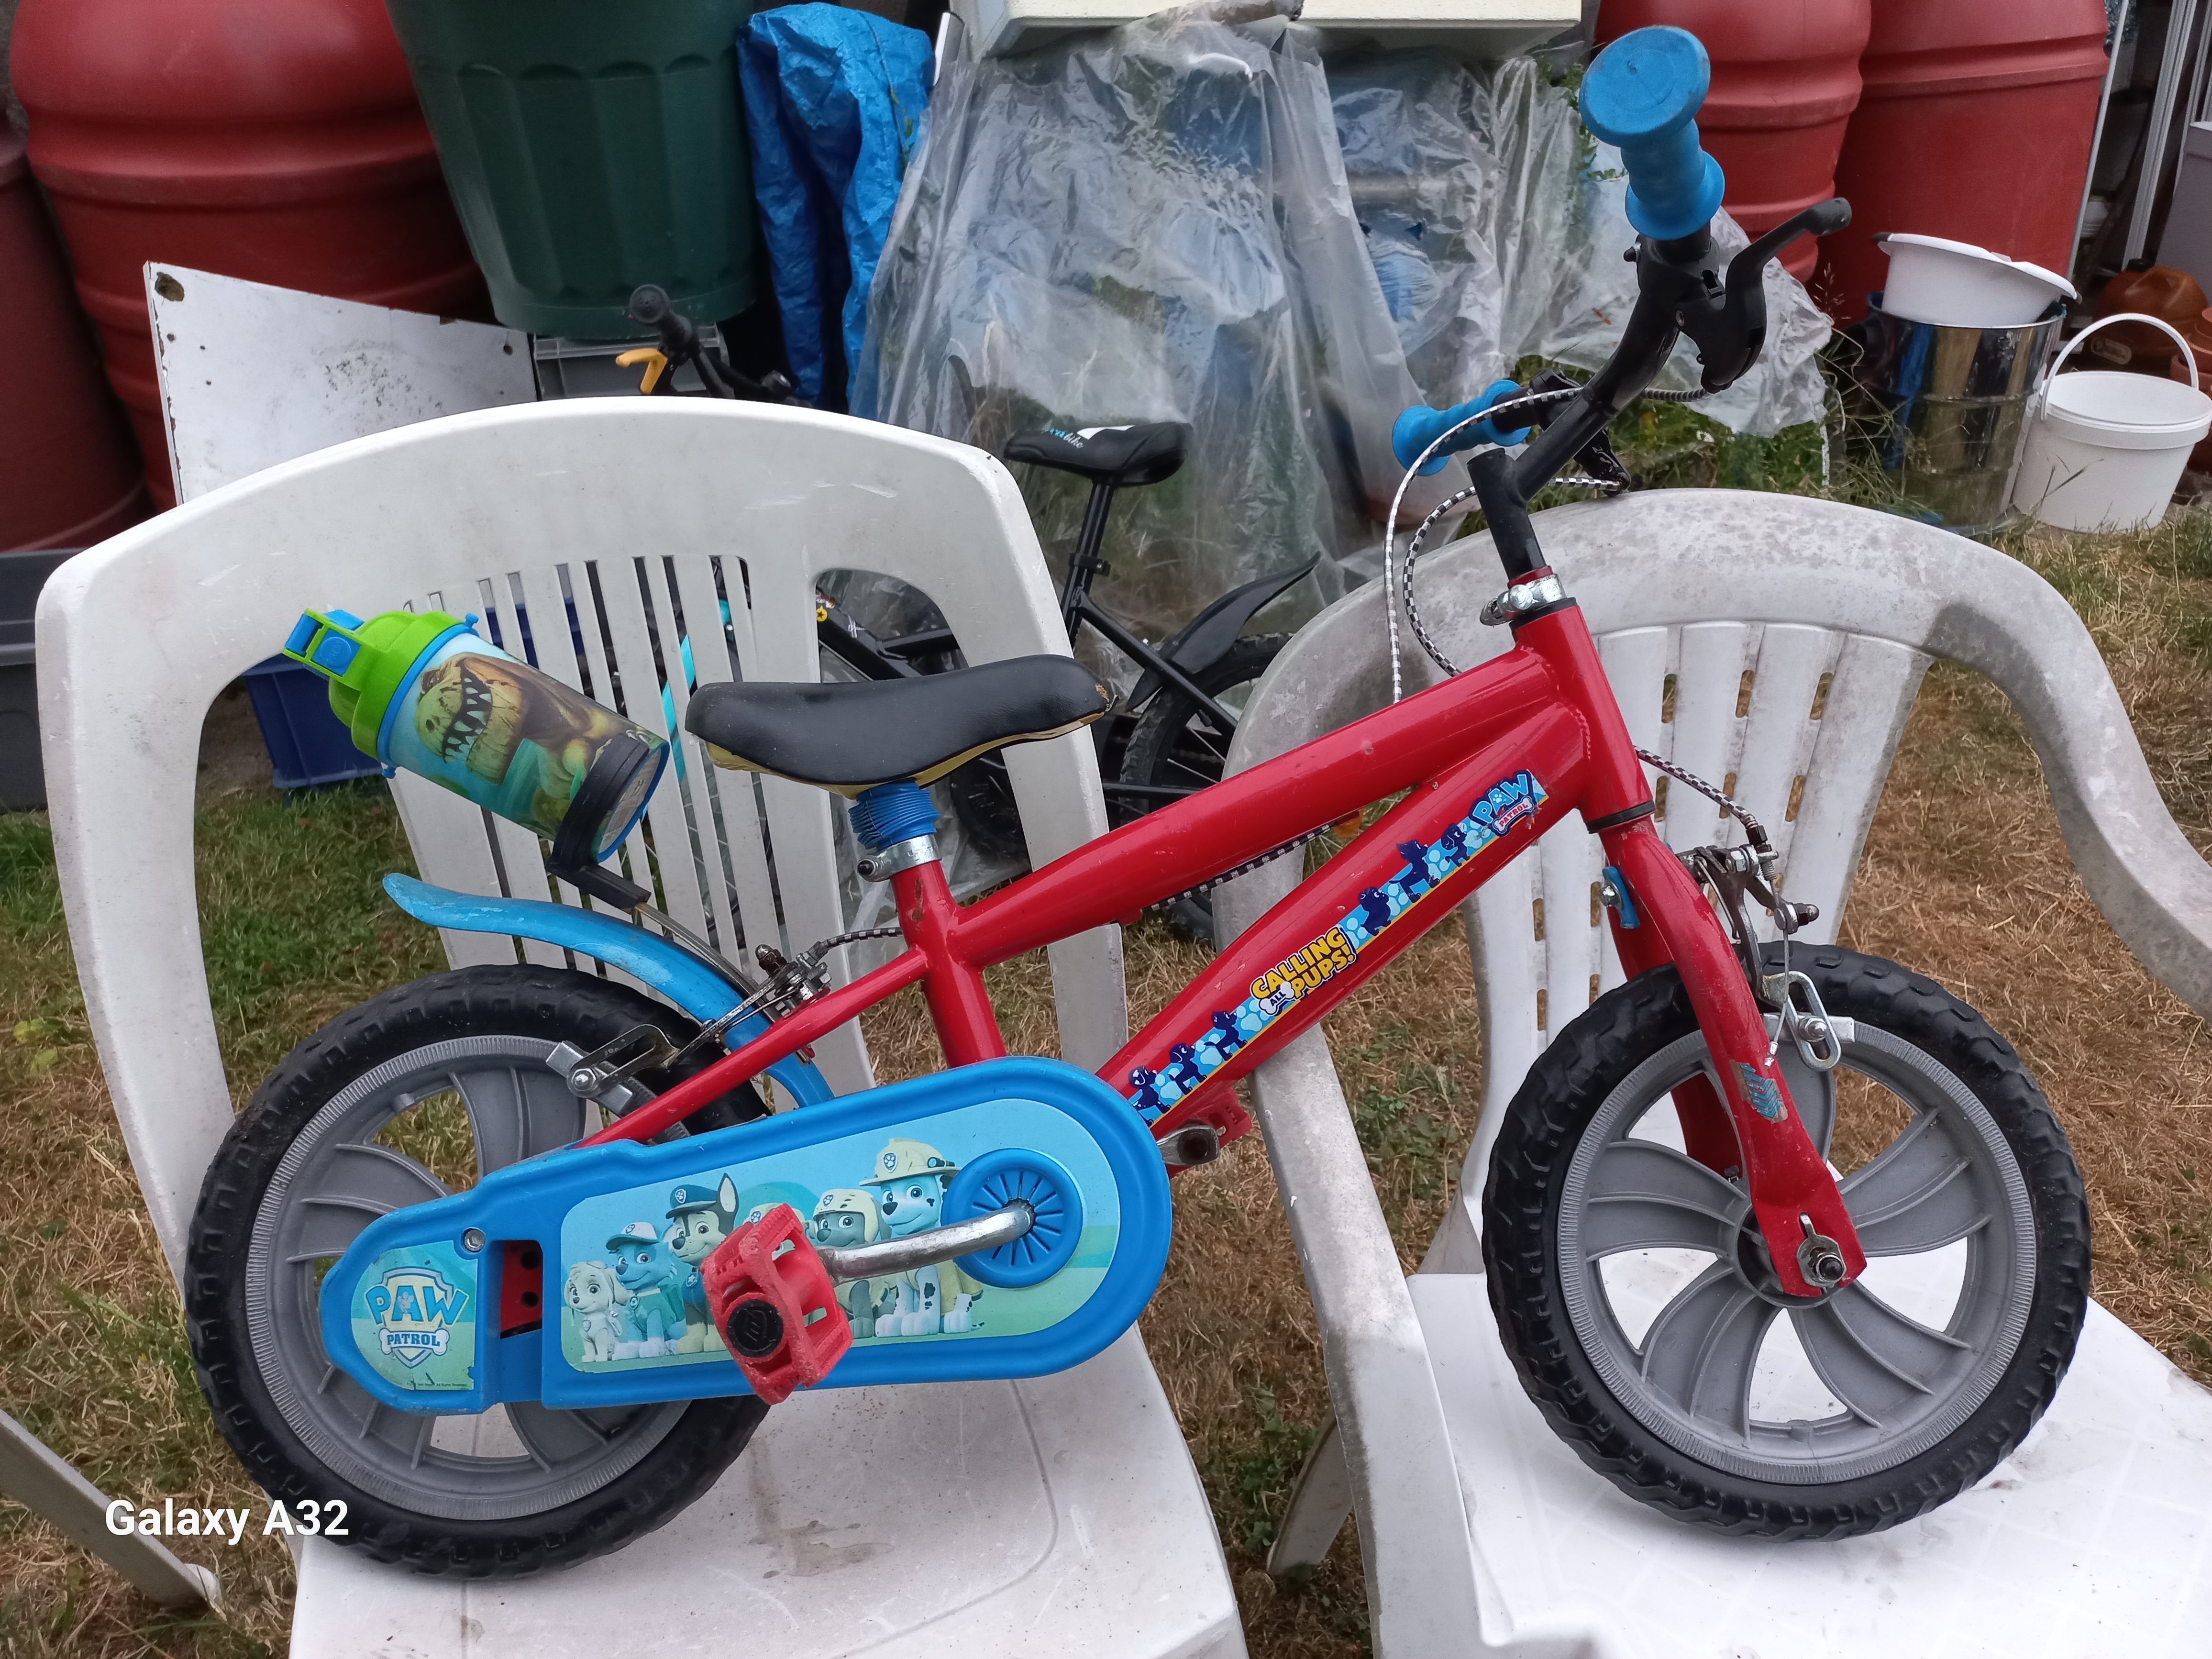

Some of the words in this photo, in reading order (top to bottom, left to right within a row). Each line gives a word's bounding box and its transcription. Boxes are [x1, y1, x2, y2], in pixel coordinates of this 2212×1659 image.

[1472, 774, 1529, 824] PAW
[1499, 803, 1528, 828] PATROL
[1251, 928, 1345, 998] CALLING
[1270, 992, 1286, 1006] ALL
[1291, 944, 1354, 998] PUPS!
[365, 1285, 469, 1325] PAW
[387, 1332, 441, 1347] PATROL
